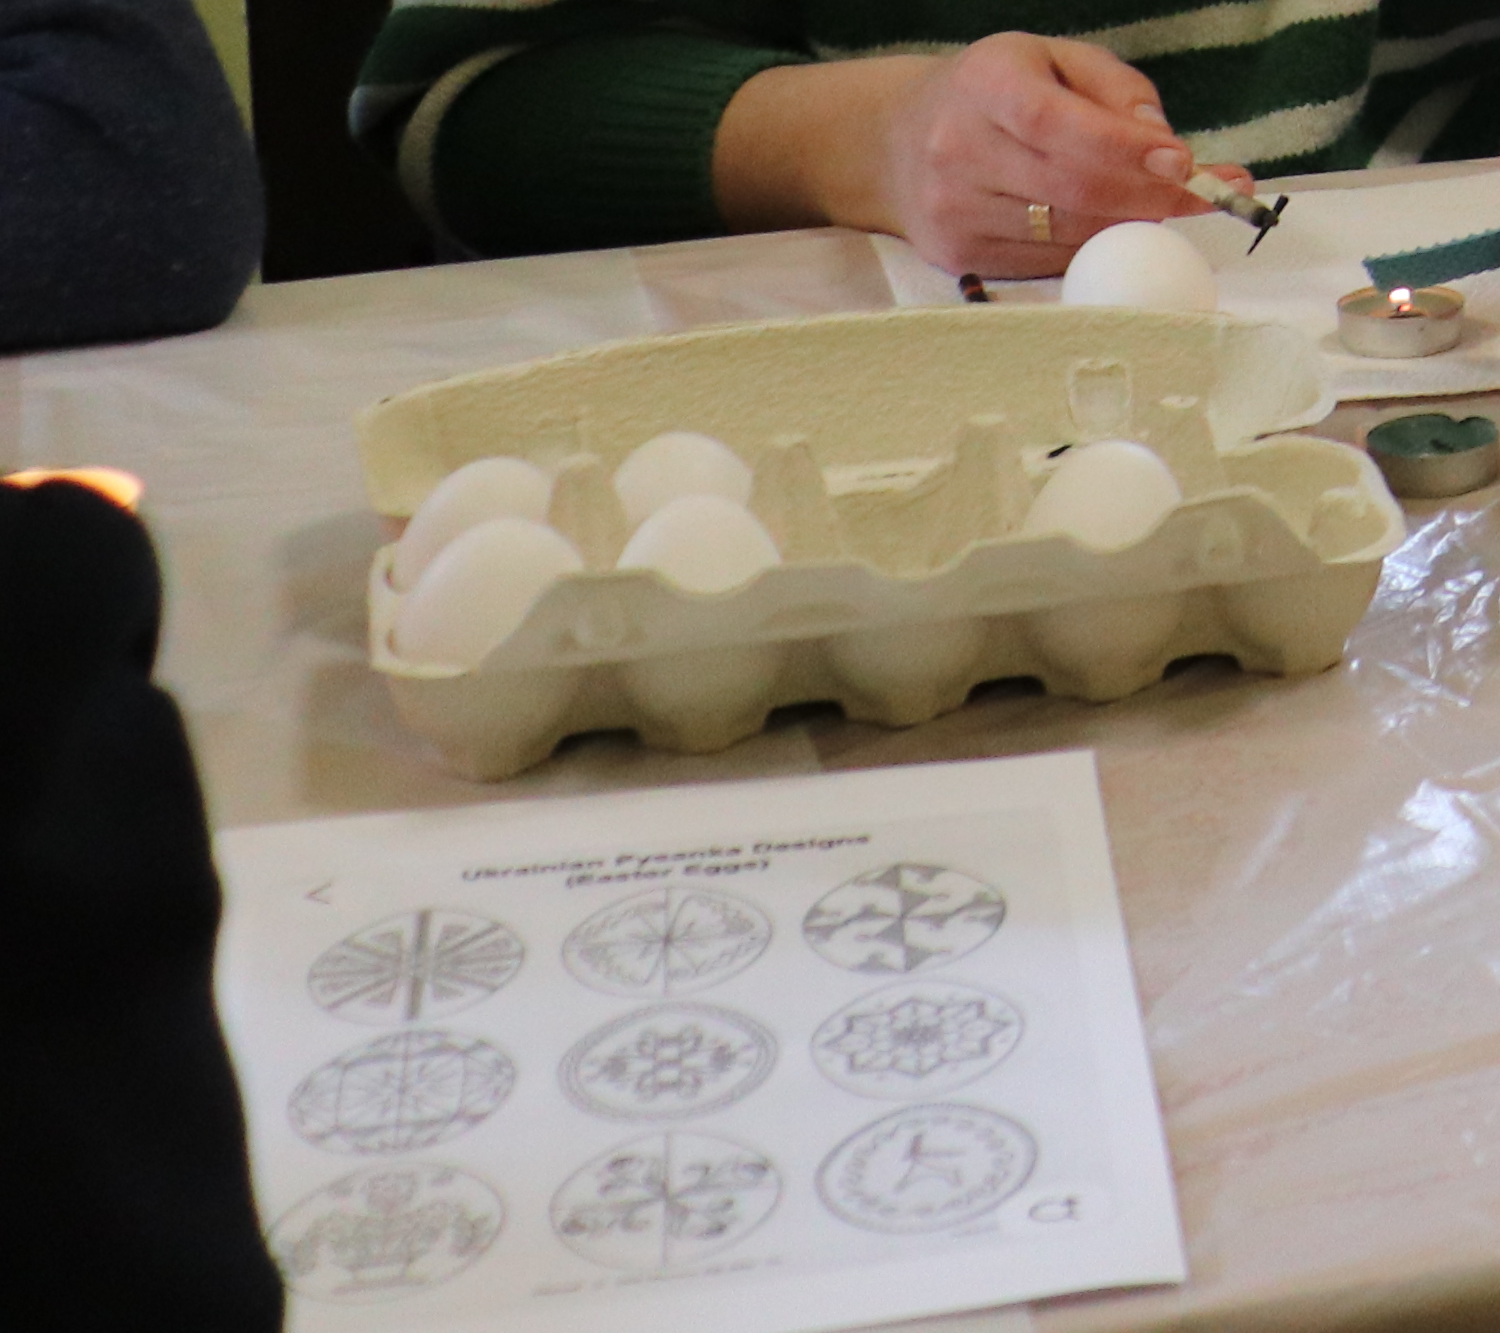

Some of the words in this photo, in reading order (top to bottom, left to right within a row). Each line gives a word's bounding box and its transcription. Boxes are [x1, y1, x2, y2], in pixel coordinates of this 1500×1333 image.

[463, 859, 603, 881] Ukrainian
[615, 845, 742, 869] Pysanka
[752, 835, 870, 854] Designs
[566, 867, 672, 889] (Easter
[683, 858, 769, 878] Eggs)
